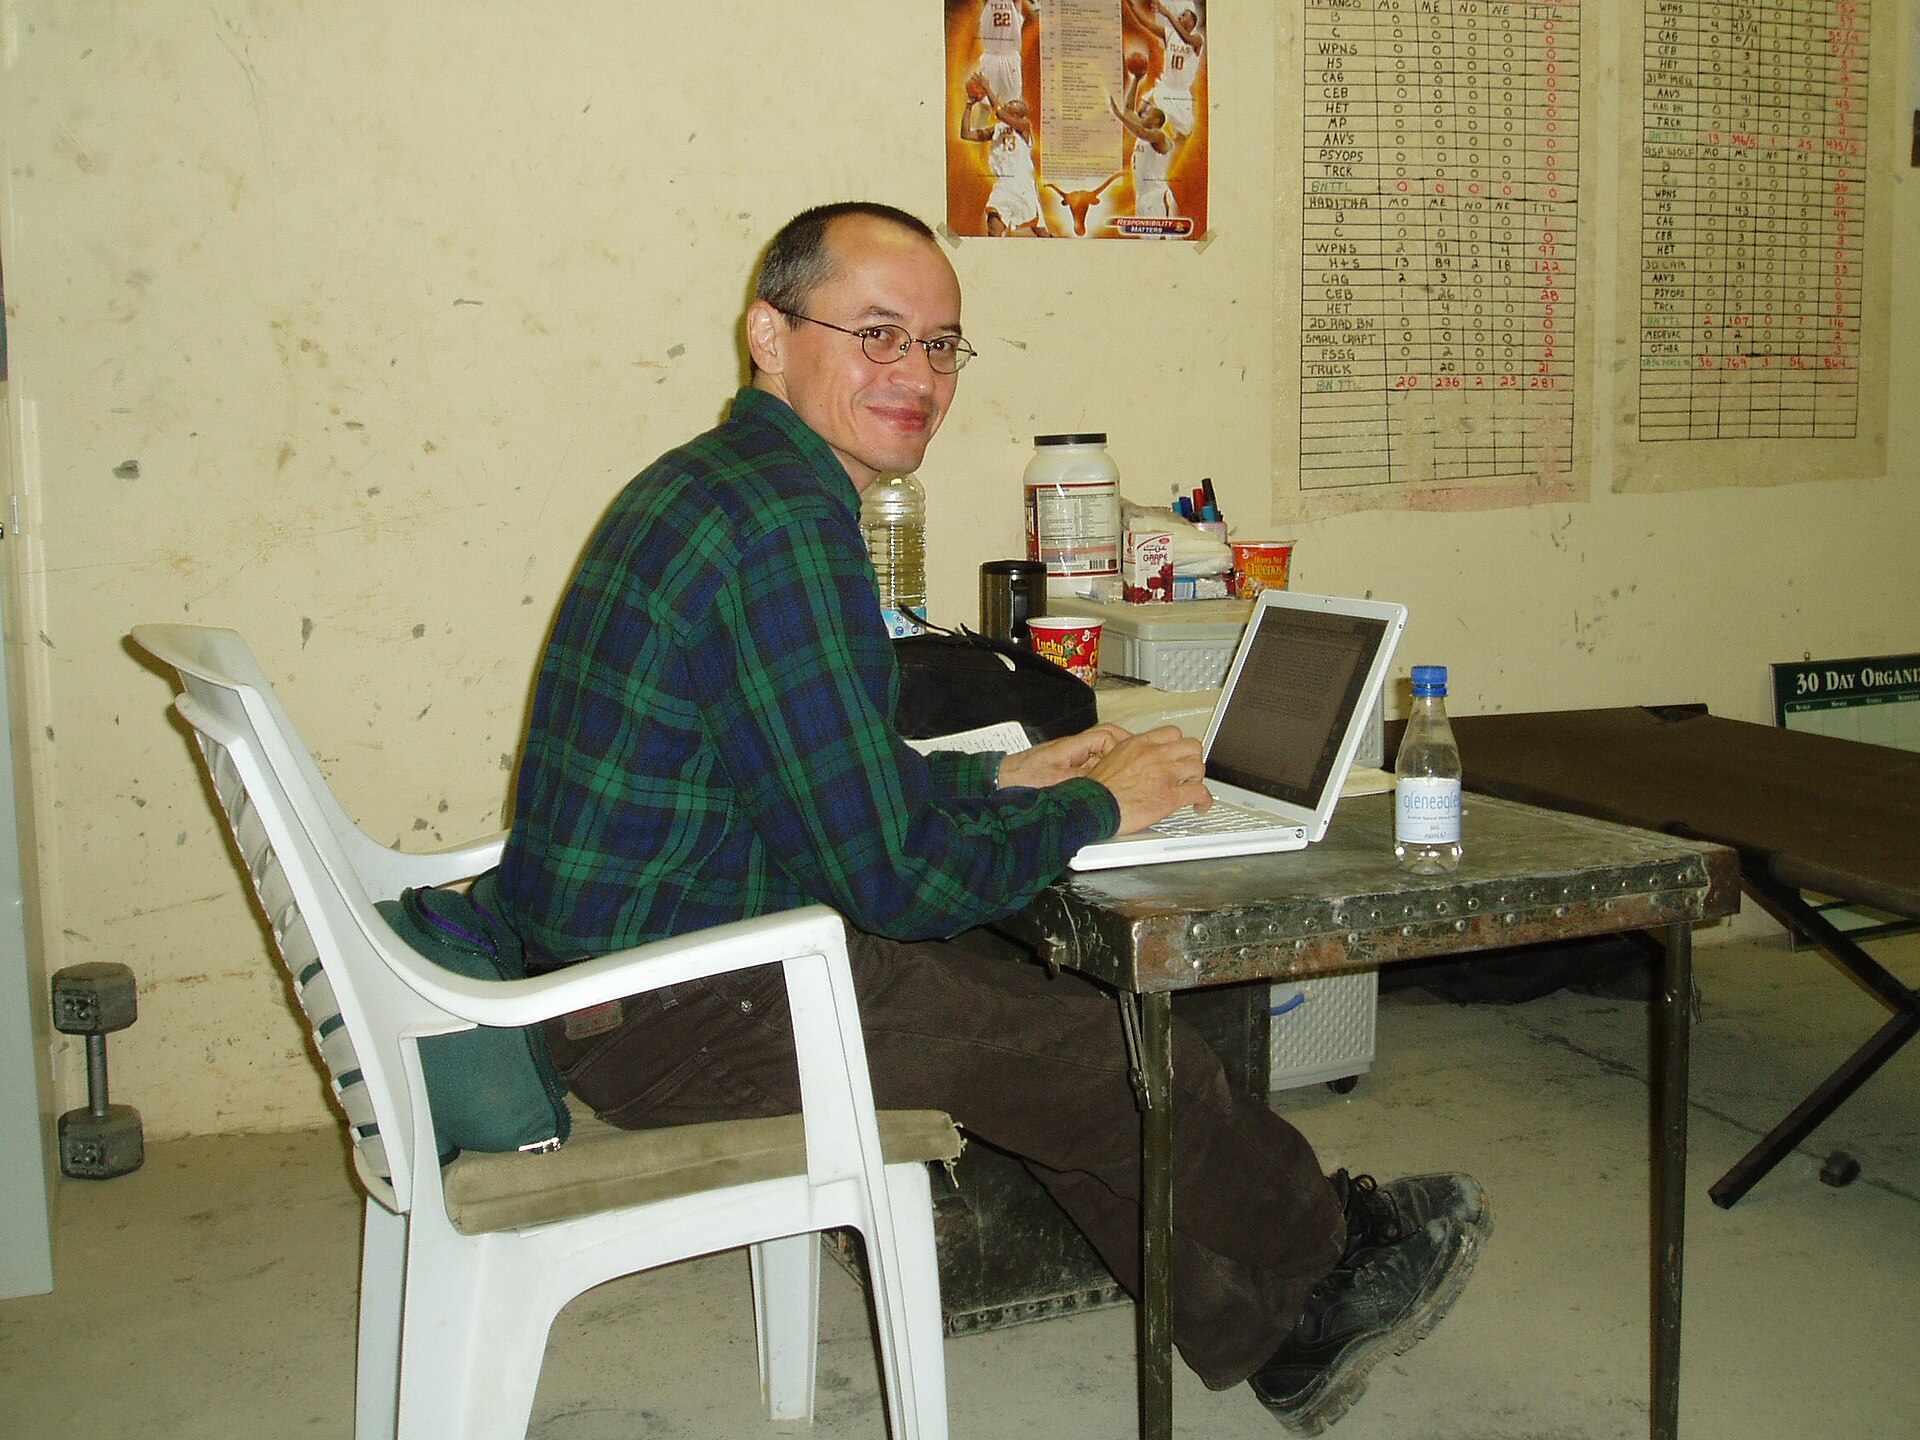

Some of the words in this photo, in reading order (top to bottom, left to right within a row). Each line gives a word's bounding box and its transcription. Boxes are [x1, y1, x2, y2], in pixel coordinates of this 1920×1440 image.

[1378, 0, 1399, 10] MO
[1422, 1, 1440, 13] ME
[1459, 2, 1477, 13] NO
[1492, 5, 1510, 15] NE
[1530, 7, 1562, 20] TTL
[993, 12, 1010, 27] 22
[1712, 21, 1719, 29] 4
[1332, 27, 1340, 38] C
[1318, 43, 1358, 55] WPNS
[1171, 55, 1183, 70] 10
[1327, 57, 1342, 69] HS
[1322, 72, 1344, 83] CAG
[1324, 88, 1348, 99] CEB
[1326, 103, 1349, 113] HET
[1328, 118, 1347, 129] MP
[1740, 121, 1746, 130] 4
[1323, 132, 1355, 145] AAV'S
[1320, 150, 1363, 162] PSYOPS
[1703, 148, 1718, 156] MO
[1324, 165, 1353, 177] TRCK
[1309, 197, 1368, 209] HADITHA
[1388, 198, 1409, 207] MO
[1429, 199, 1446, 208] ME
[1464, 202, 1482, 210] NO
[1496, 202, 1510, 210] NE
[1532, 203, 1556, 213] TTL
[1735, 206, 1749, 216] 43
[1117, 218, 1173, 226] RESPONSIBILITY
[1336, 212, 1344, 222] B
[1334, 227, 1344, 237] C
[1316, 242, 1357, 254] WPNS
[1436, 242, 1448, 254] 91
[1471, 244, 1479, 254] 0
[1501, 245, 1510, 255] 4
[1539, 246, 1556, 256] 97
[1657, 244, 1675, 254] HET
[1395, 258, 1409, 267] 13
[1435, 258, 1450, 268] 89
[1472, 259, 1479, 269] 2
[1498, 260, 1511, 271] 18
[1535, 260, 1560, 271] 122
[1322, 273, 1349, 285] CAG
[1399, 273, 1405, 282] 2
[1440, 273, 1447, 282] 3
[1546, 276, 1553, 286] 5
[1326, 288, 1353, 300] CEB
[1541, 290, 1559, 301] 28
[1326, 302, 1352, 314] HET
[1441, 303, 1449, 314] 4
[1545, 304, 1553, 315] 5
[1736, 303, 1742, 311] 5
[1331, 318, 1352, 330] RAD
[1357, 318, 1374, 328] BN
[1401, 318, 1409, 327] 0
[1442, 317, 1450, 327] 0
[1474, 318, 1482, 328] 0
[1504, 318, 1513, 328] 0
[1544, 318, 1553, 329] 0
[1704, 316, 1712, 325] 2
[1729, 316, 1748, 325] 107
[1403, 332, 1412, 341] 0
[1443, 332, 1451, 341] 0
[1503, 333, 1512, 344] 0
[1544, 334, 1554, 345] 0
[1645, 330, 1680, 340] MEDEVAC
[1704, 330, 1712, 340] 0
[1734, 330, 1742, 339] 2
[1322, 349, 1355, 360] FSSG
[1401, 347, 1410, 356] 0
[1443, 347, 1453, 356] 2
[1545, 348, 1554, 357] 2
[1650, 344, 1680, 353] OTHER
[1307, 364, 1352, 375] TRUCK
[1440, 363, 1455, 372] 20
[1539, 363, 1548, 372] 21
[1727, 358, 1747, 368] 769
[1396, 376, 1417, 387] 20
[1436, 377, 1460, 387] 236
[1476, 377, 1484, 386] 2
[1500, 376, 1517, 387] 23
[1531, 377, 1554, 388] 281
[1143, 553, 1168, 562] GRAPE
[1036, 638, 1064, 656] Lucky
[1796, 672, 1820, 695] 30
